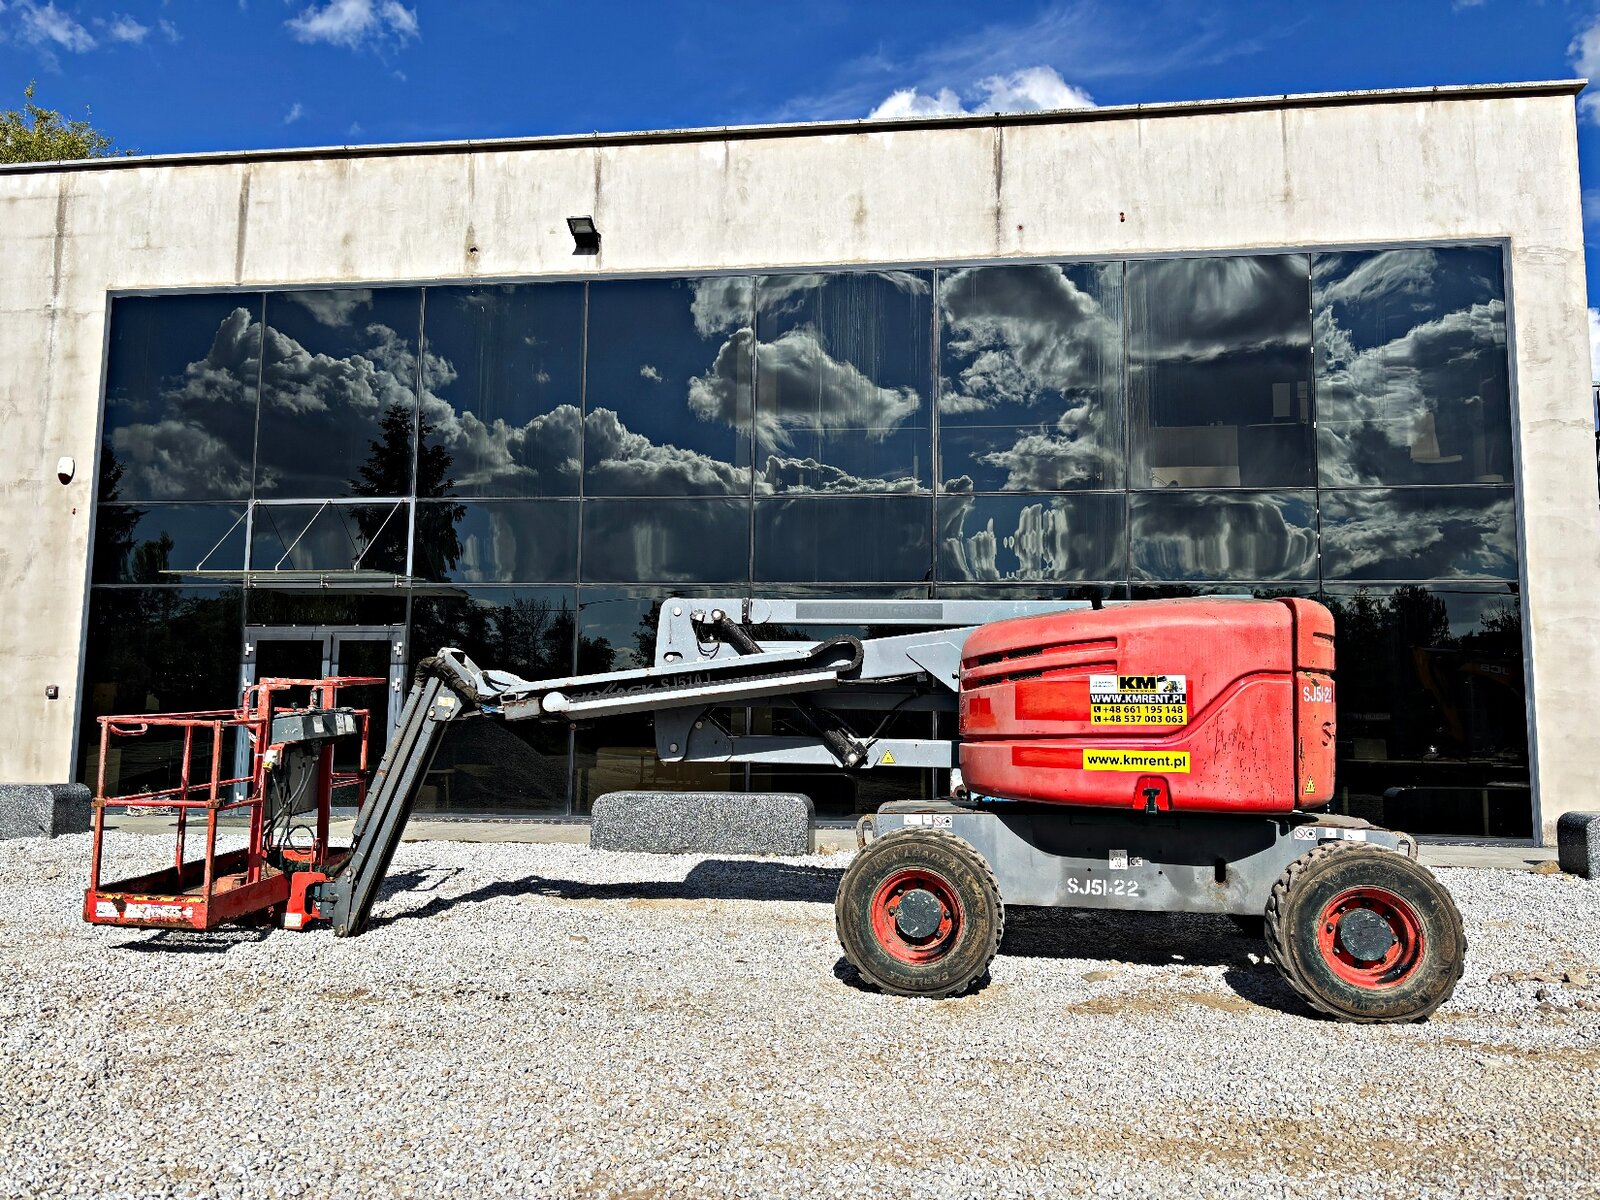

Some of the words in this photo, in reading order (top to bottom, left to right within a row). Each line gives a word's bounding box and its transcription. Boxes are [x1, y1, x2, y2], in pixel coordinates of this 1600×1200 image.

[1119, 676, 1157, 689] KM
[1090, 694, 1186, 704] WWW.KMRENT.PL
[1103, 706, 1121, 714] +48
[1123, 706, 1141, 714] 661
[1145, 706, 1162, 714] 195
[1165, 706, 1183, 714] 148
[1103, 715, 1121, 723] +48
[1124, 715, 1141, 723] 537
[1145, 715, 1162, 723] 003
[1165, 715, 1183, 723] 063
[1087, 754, 1186, 768] www.kmrent.pl
